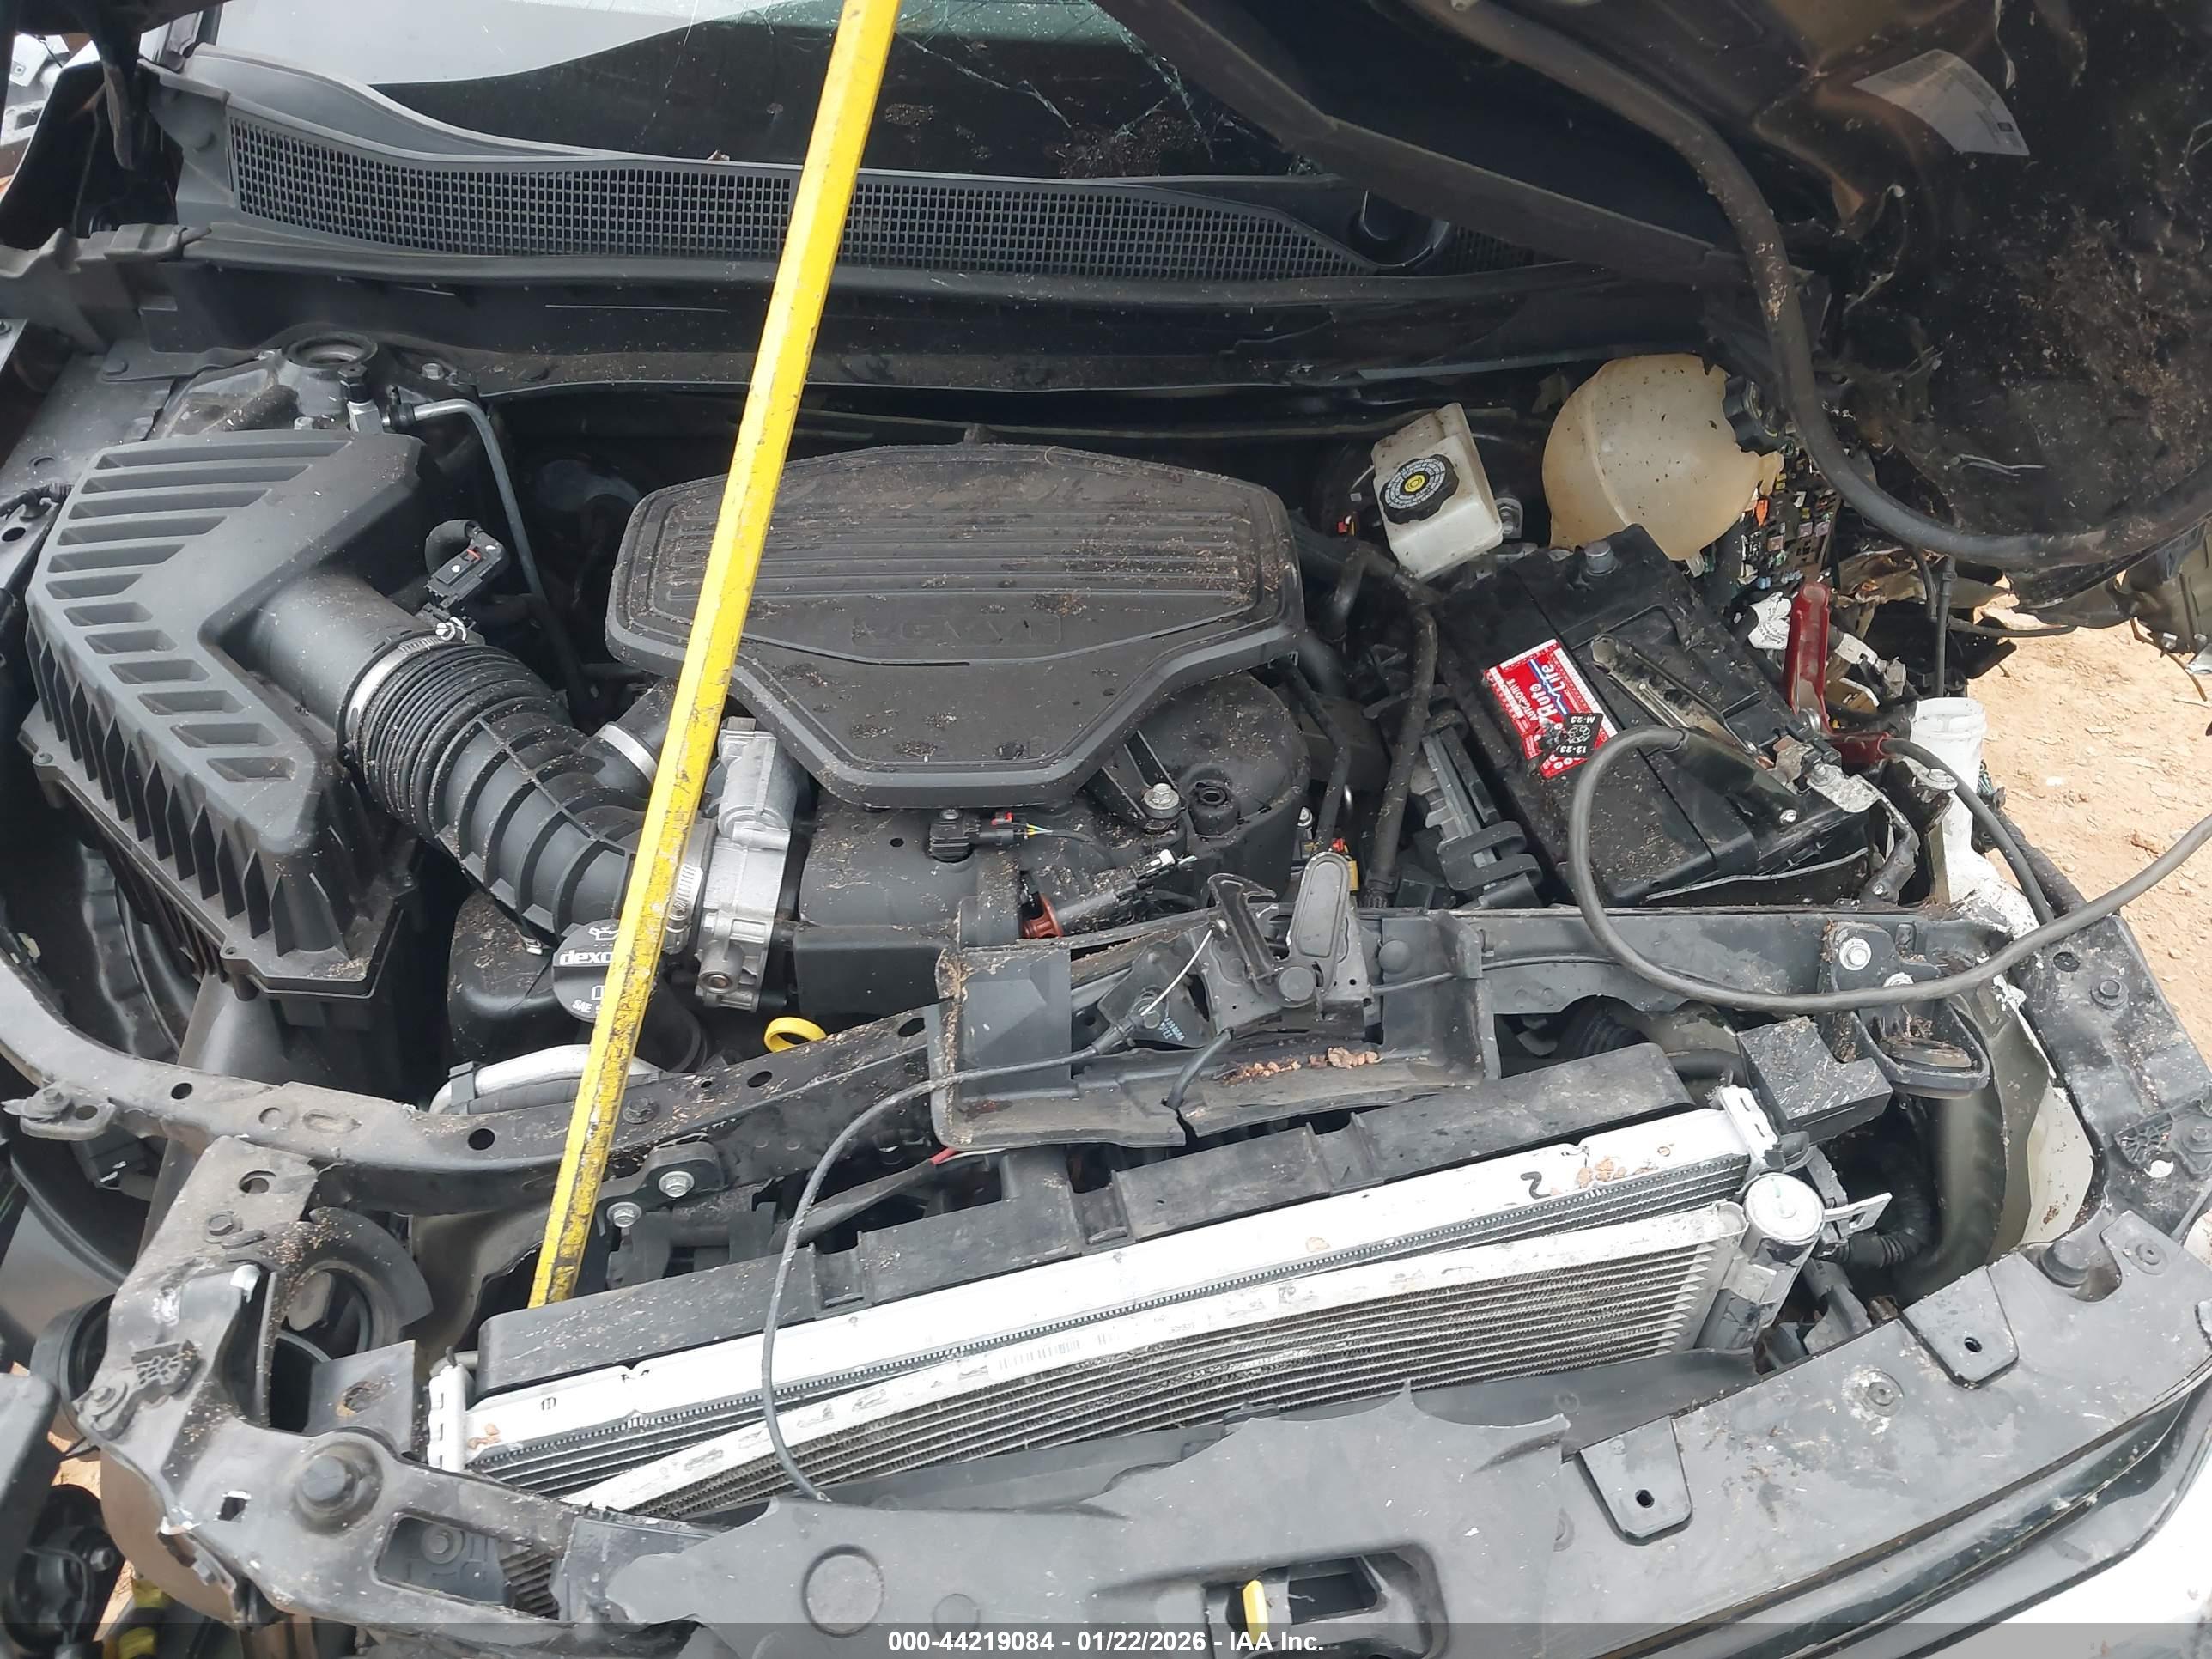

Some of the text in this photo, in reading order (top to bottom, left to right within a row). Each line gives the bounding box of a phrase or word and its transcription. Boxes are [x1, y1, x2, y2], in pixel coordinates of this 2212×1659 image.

[1530, 684, 1558, 717] Auto
[560, 950, 613, 965] dexo
[572, 999, 592, 1013] SAE
